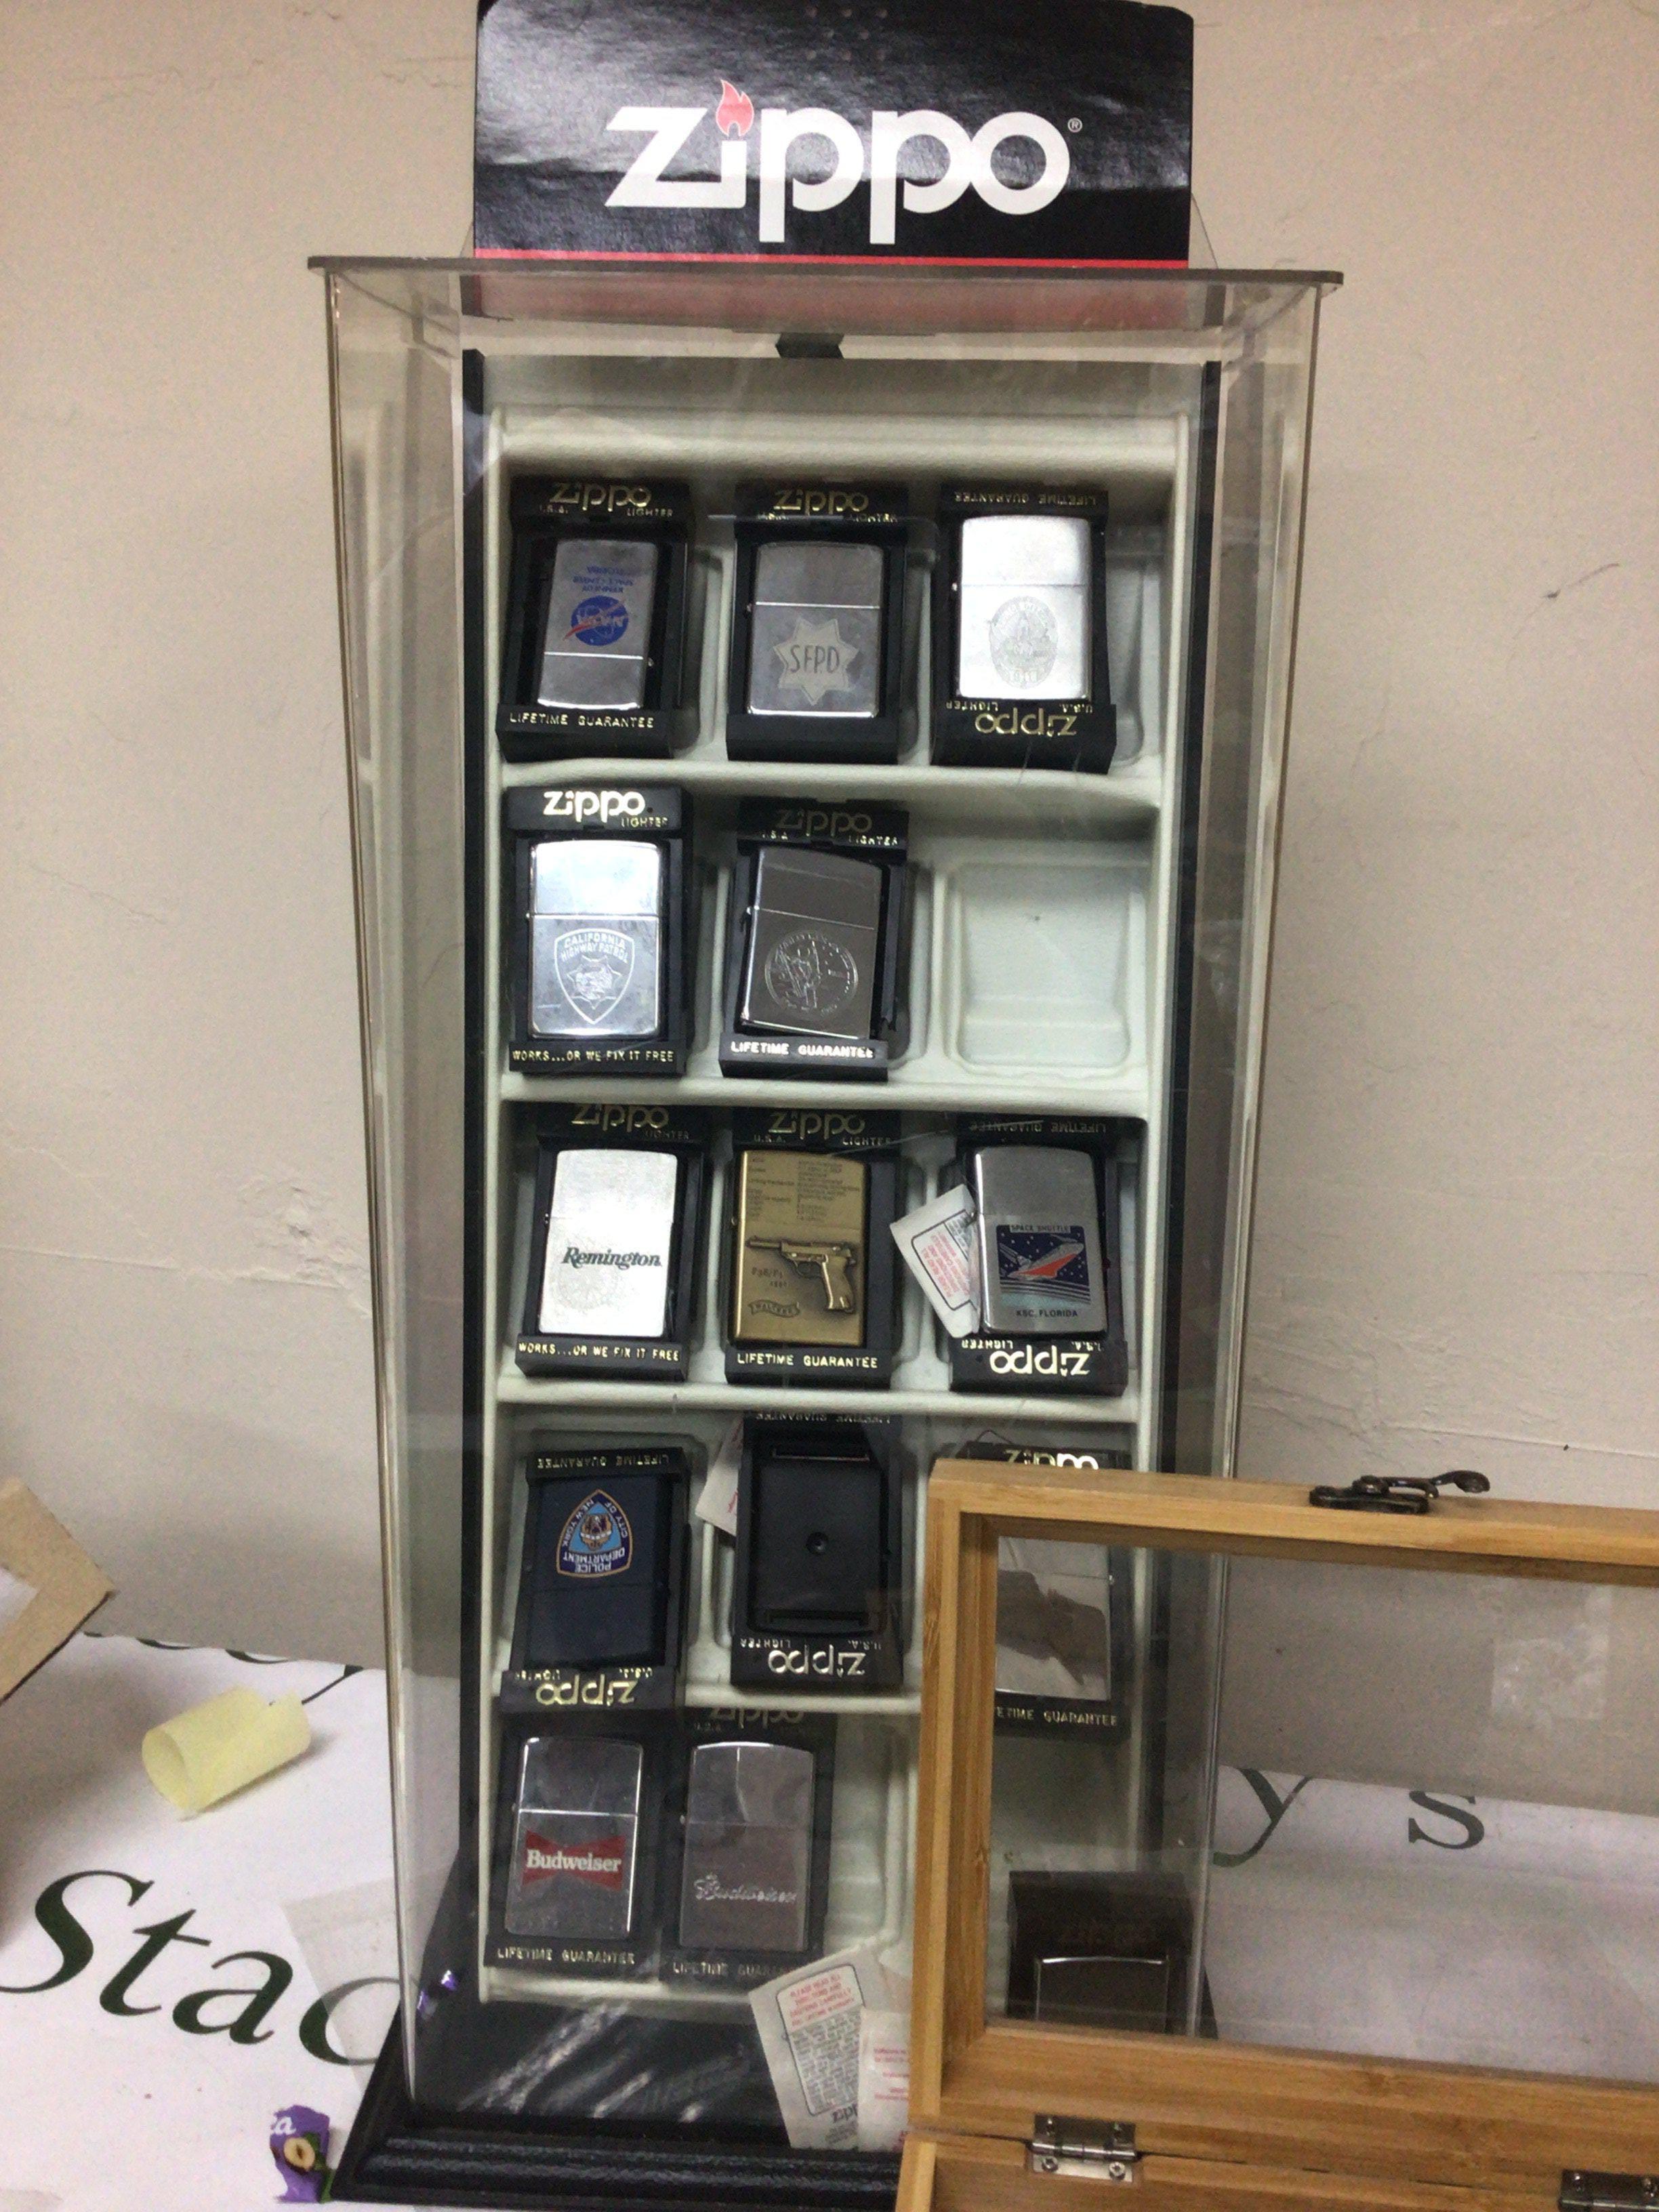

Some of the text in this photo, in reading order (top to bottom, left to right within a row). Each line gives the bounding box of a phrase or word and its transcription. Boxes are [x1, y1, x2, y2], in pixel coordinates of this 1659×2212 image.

[605, 80, 1069, 244] Zippo
[549, 483, 651, 512] Zippo
[773, 489, 869, 516] Zippo
[954, 491, 1097, 505] LIFETIME GUARANTEE
[627, 508, 674, 518] LIGHTER
[790, 644, 840, 675] SFPD
[946, 701, 999, 712] LIGHTER
[510, 712, 655, 729] LIFETIME GUARANTEE
[975, 708, 1077, 737] Zippo
[544, 791, 646, 823] Zippo
[621, 816, 668, 827] LIGHTER
[564, 932, 626, 950] CALIFORNIA
[560, 943, 598, 962] HIGHWAY
[586, 1050, 602, 1062] WE
[607, 1050, 626, 1062] FIX
[629, 1050, 640, 1062] IT
[646, 1050, 674, 1063] FREE
[731, 1041, 874, 1059] LIFETIME GUARANTEE
[571, 1105, 669, 1132] Zippo
[769, 1111, 865, 1141] Zippo
[562, 1247, 661, 1271] Remington
[1040, 1309, 1078, 1317] FLORIDA
[593, 1343, 608, 1357] WE
[614, 1345, 631, 1358] FIX
[636, 1345, 647, 1358] IT
[653, 1347, 679, 1361] FREE
[961, 1338, 1014, 1349] LIGHTER
[737, 1353, 878, 1369] LIFETIME GUARANTEE
[989, 1345, 1090, 1376] Zippo
[538, 1456, 607, 1469] GUARANTEE
[562, 1499, 594, 1547] NEW YORK
[615, 1516, 628, 1538] CITY
[563, 1547, 625, 1564] DEPARTMENT
[575, 1561, 612, 1573] POLICE
[741, 1637, 792, 1648] LIGHTER
[768, 1644, 865, 1677] Zippo
[535, 1674, 638, 1706] Zippo
[1044, 1711, 1118, 1727] GUARANTEE
[526, 1849, 622, 1873] Budweiser
[497, 1947, 635, 1965] LIFETIME GUARANTEE
